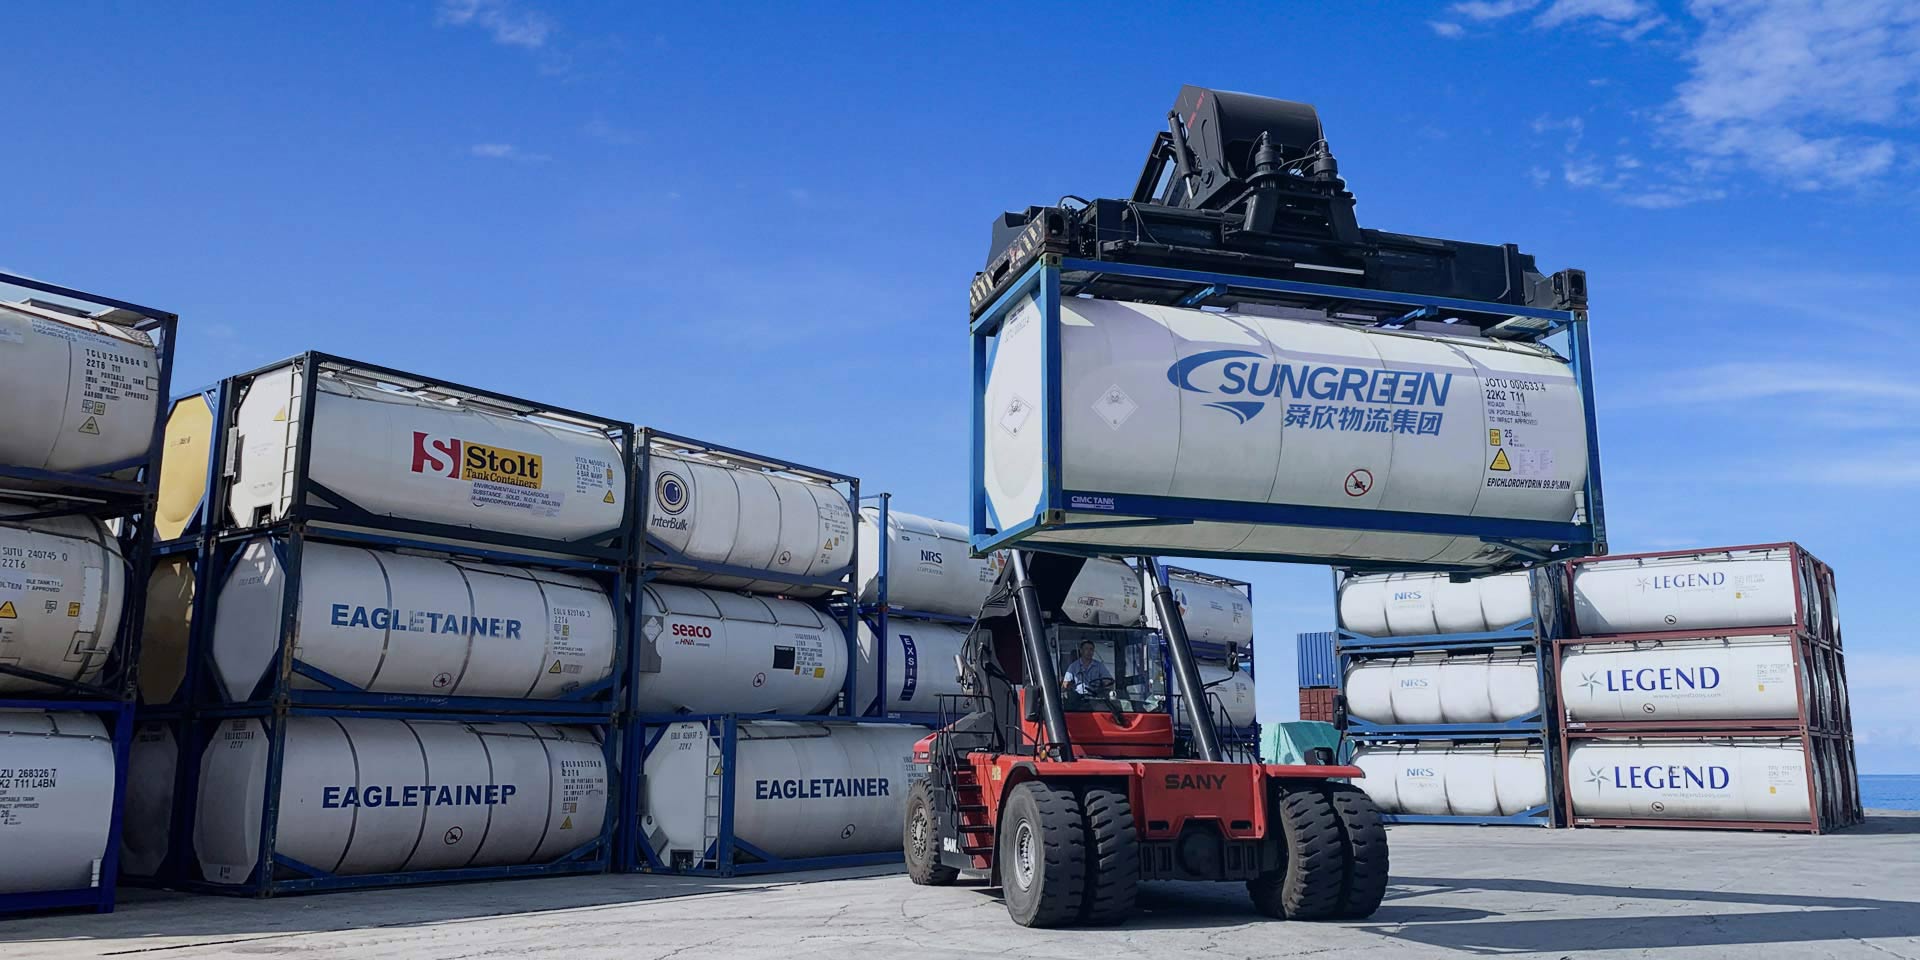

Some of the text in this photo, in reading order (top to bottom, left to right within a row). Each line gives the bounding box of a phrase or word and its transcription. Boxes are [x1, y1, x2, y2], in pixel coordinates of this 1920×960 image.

[86, 358, 106, 370] 22T6
[132, 378, 144, 386] TANK
[1218, 361, 1453, 407] SUNGREEN
[1485, 378, 1507, 389] JOTU
[1510, 380, 1539, 392] 000633
[1486, 390, 1526, 403] 22K2 T11
[1284, 403, 1443, 436] 舜欣物流集团
[1496, 409, 1520, 417] PORTABLE
[1514, 418, 1538, 426] APPROVED
[1504, 429, 1513, 438] 25
[1508, 438, 1513, 447] 4
[466, 446, 539, 479] Stolt
[490, 472, 538, 489] Containers
[1486, 478, 1542, 489] EPICHLOROHYDRIN
[473, 482, 520, 495] ENVIRONMENTALLY
[1071, 496, 1114, 505] CIMC TANK
[651, 514, 688, 531] InterBulk
[2, 547, 68, 562] SUTU 240745 0
[920, 549, 943, 565] NRS
[2, 558, 26, 569] 22T6
[1653, 571, 1725, 590] LEGEND
[1394, 590, 1422, 601] NRS
[672, 623, 712, 639] seaco
[903, 637, 915, 687] EXSIF
[1400, 679, 1428, 688] NRS
[1606, 666, 1720, 692] LEGEND
[18, 769, 50, 778] 268326
[51, 768, 57, 778] 7
[1406, 768, 1435, 777] NRS
[1614, 765, 1730, 789] LEGEND
[14, 779, 29, 788] T11
[32, 778, 56, 788] L4BN
[1164, 773, 1227, 790] SANY
[755, 778, 889, 800] EAGLETAINER
[1, 810, 10, 818] 26
[943, 836, 960, 854] SAN
